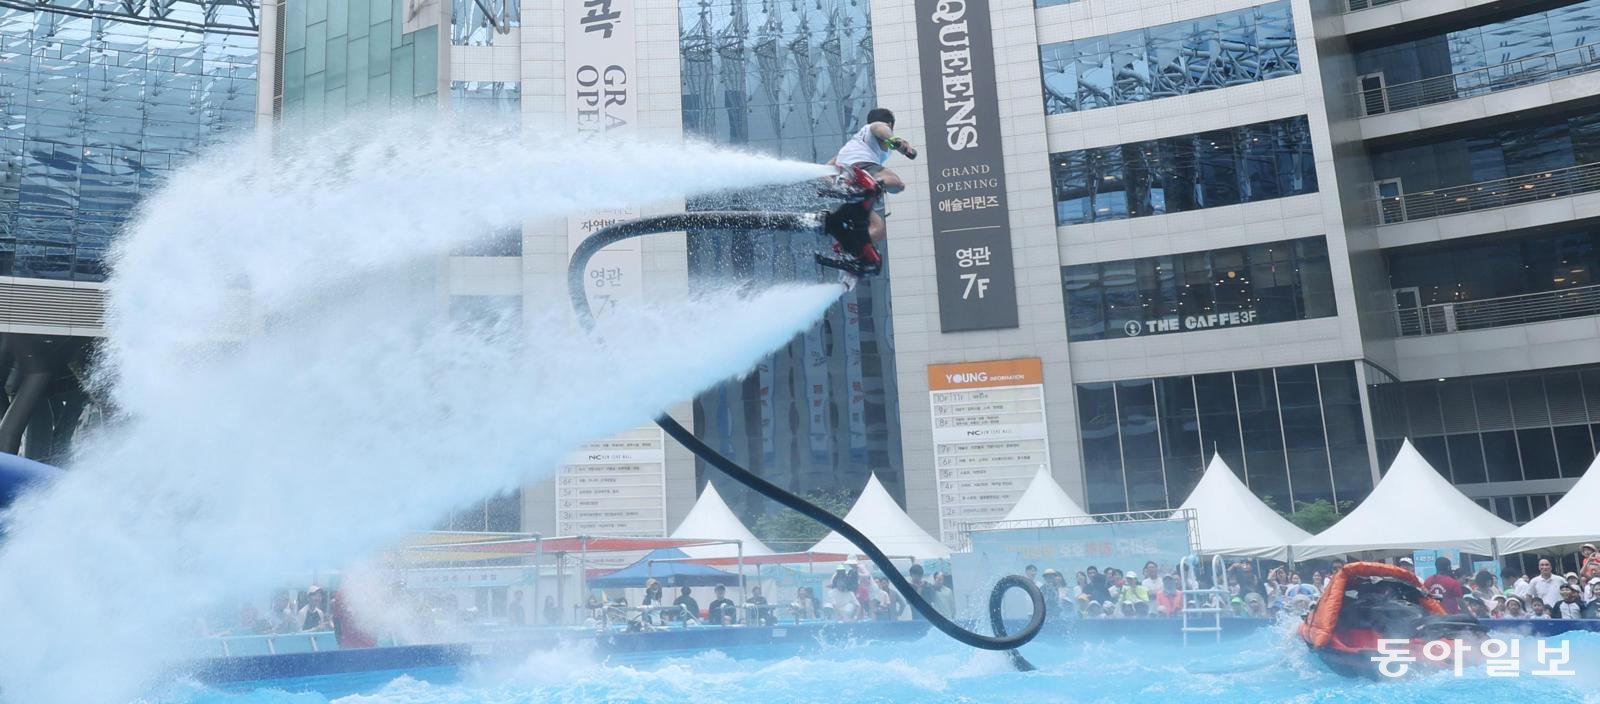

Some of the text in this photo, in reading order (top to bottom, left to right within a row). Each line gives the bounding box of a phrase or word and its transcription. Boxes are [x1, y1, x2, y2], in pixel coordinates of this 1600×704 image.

[931, 0, 979, 151] QUEENS
[941, 164, 990, 178] GRAND
[936, 178, 998, 193] OPENING
[955, 246, 992, 268] 영관
[590, 267, 623, 288] 영관
[960, 273, 990, 300] 7F
[1145, 318, 1180, 333] THE
[945, 371, 989, 384] YOUNG
